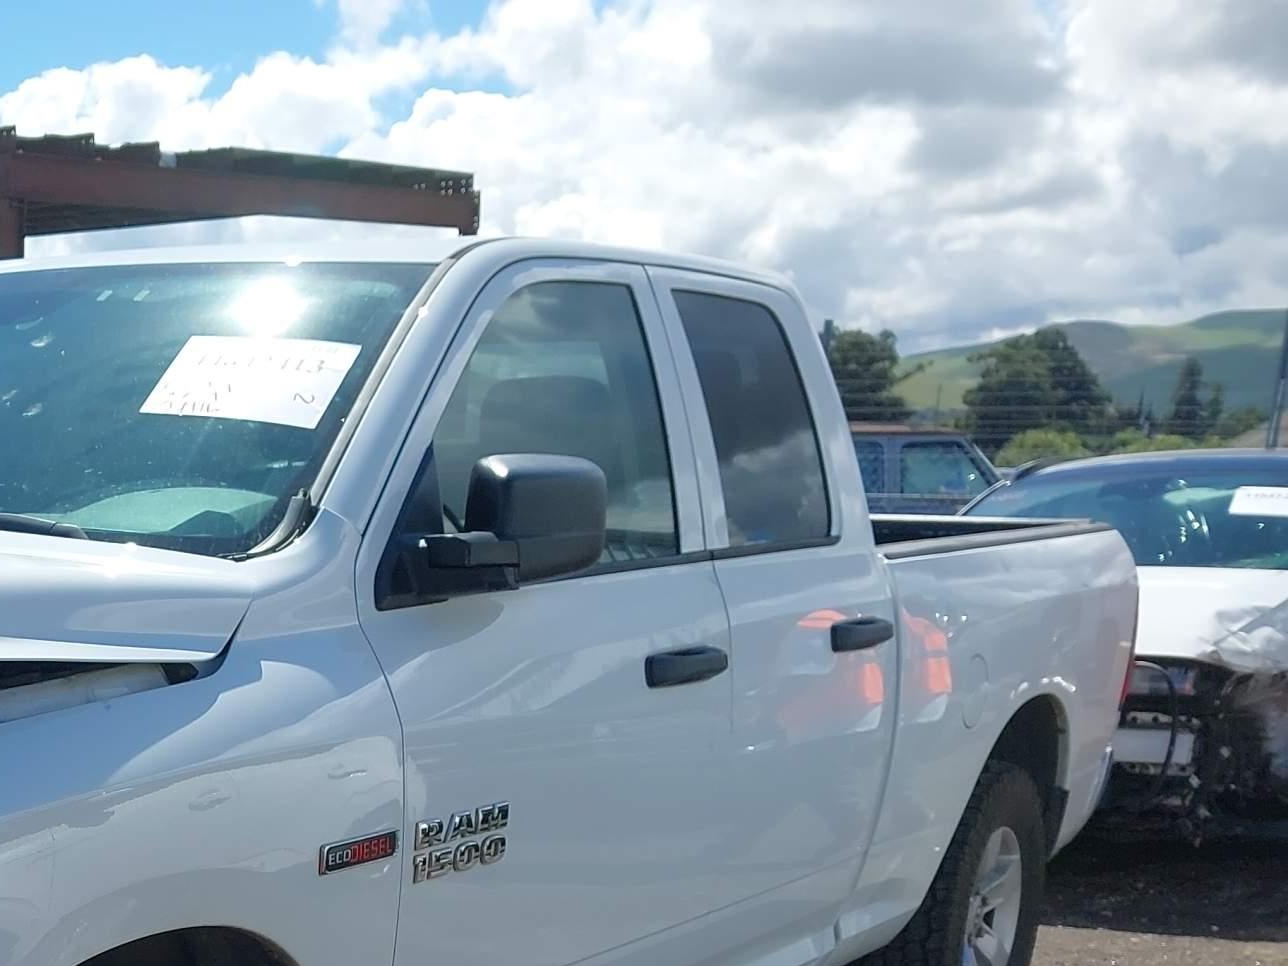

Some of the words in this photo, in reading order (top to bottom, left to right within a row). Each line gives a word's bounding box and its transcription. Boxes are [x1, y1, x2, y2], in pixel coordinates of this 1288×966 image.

[414, 800, 511, 851] RAM
[327, 836, 394, 867] ECODIESEL
[412, 834, 507, 884] 1500
